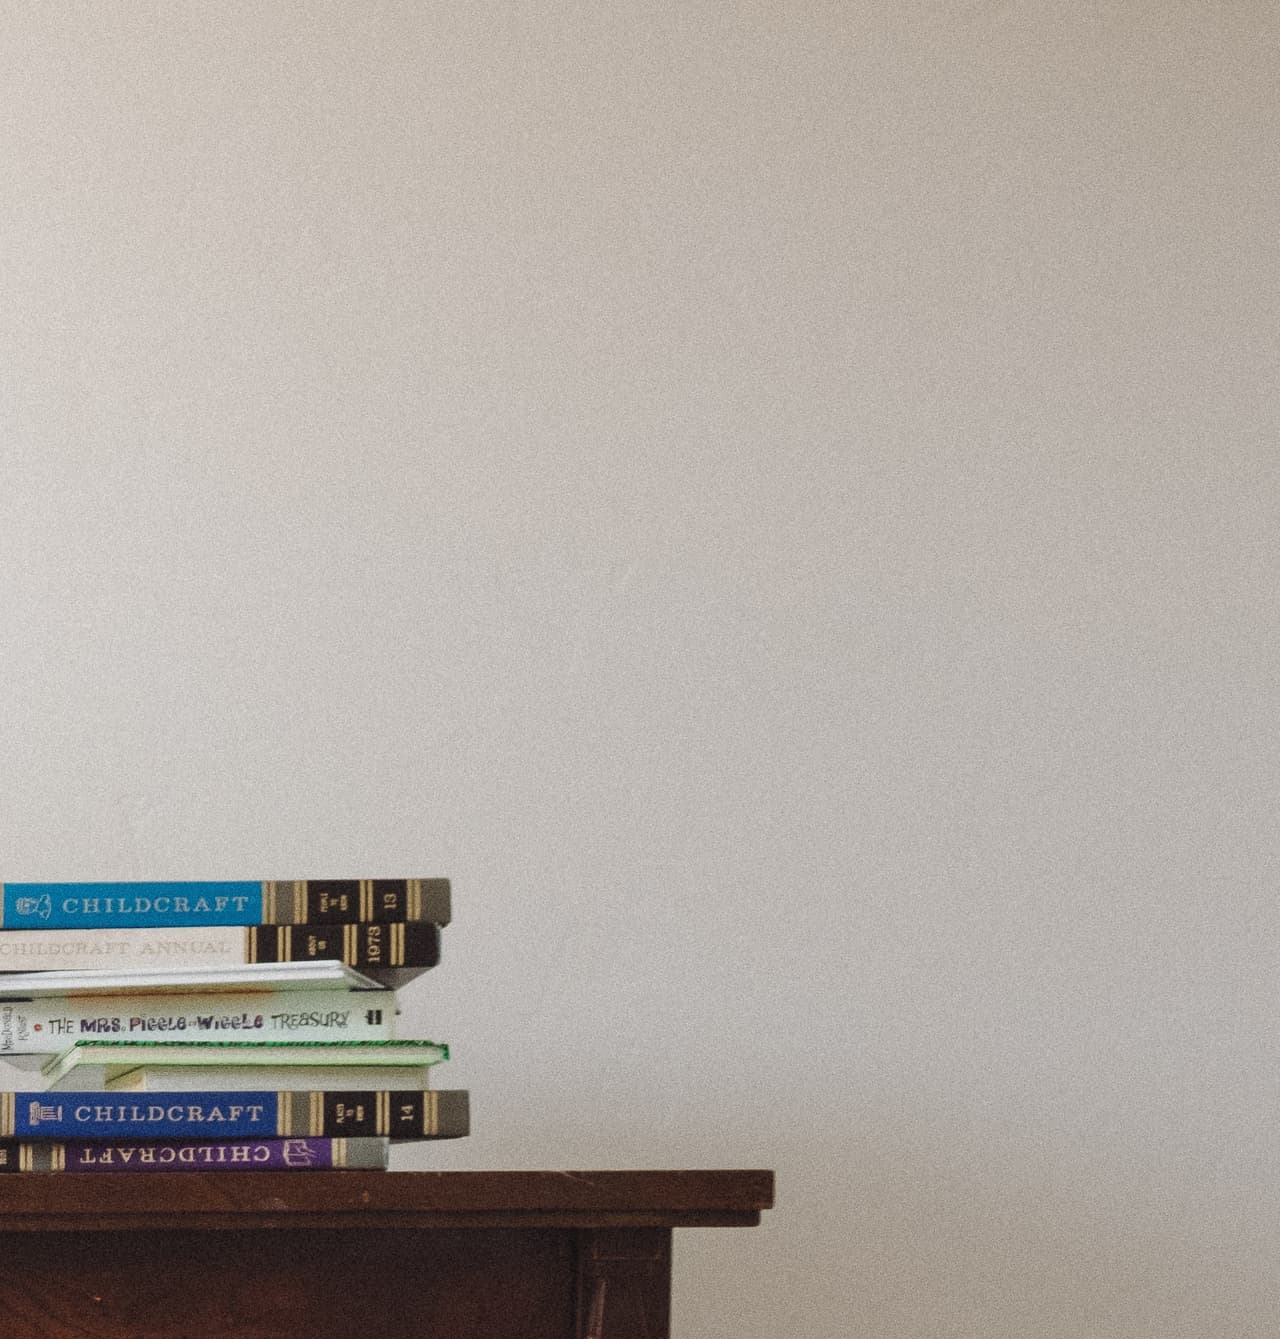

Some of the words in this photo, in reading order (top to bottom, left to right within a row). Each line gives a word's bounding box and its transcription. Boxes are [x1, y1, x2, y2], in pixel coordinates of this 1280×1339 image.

[62, 895, 249, 914] CHILDCRAFT
[383, 893, 398, 909] 13
[140, 940, 232, 956] ANNUAL
[48, 1017, 75, 1034] THE
[79, 1016, 127, 1033] MRS.
[74, 1105, 264, 1122] CHILDCRAFT
[400, 1104, 414, 1121] 14
[79, 1145, 271, 1164] CHILDCRAFT
